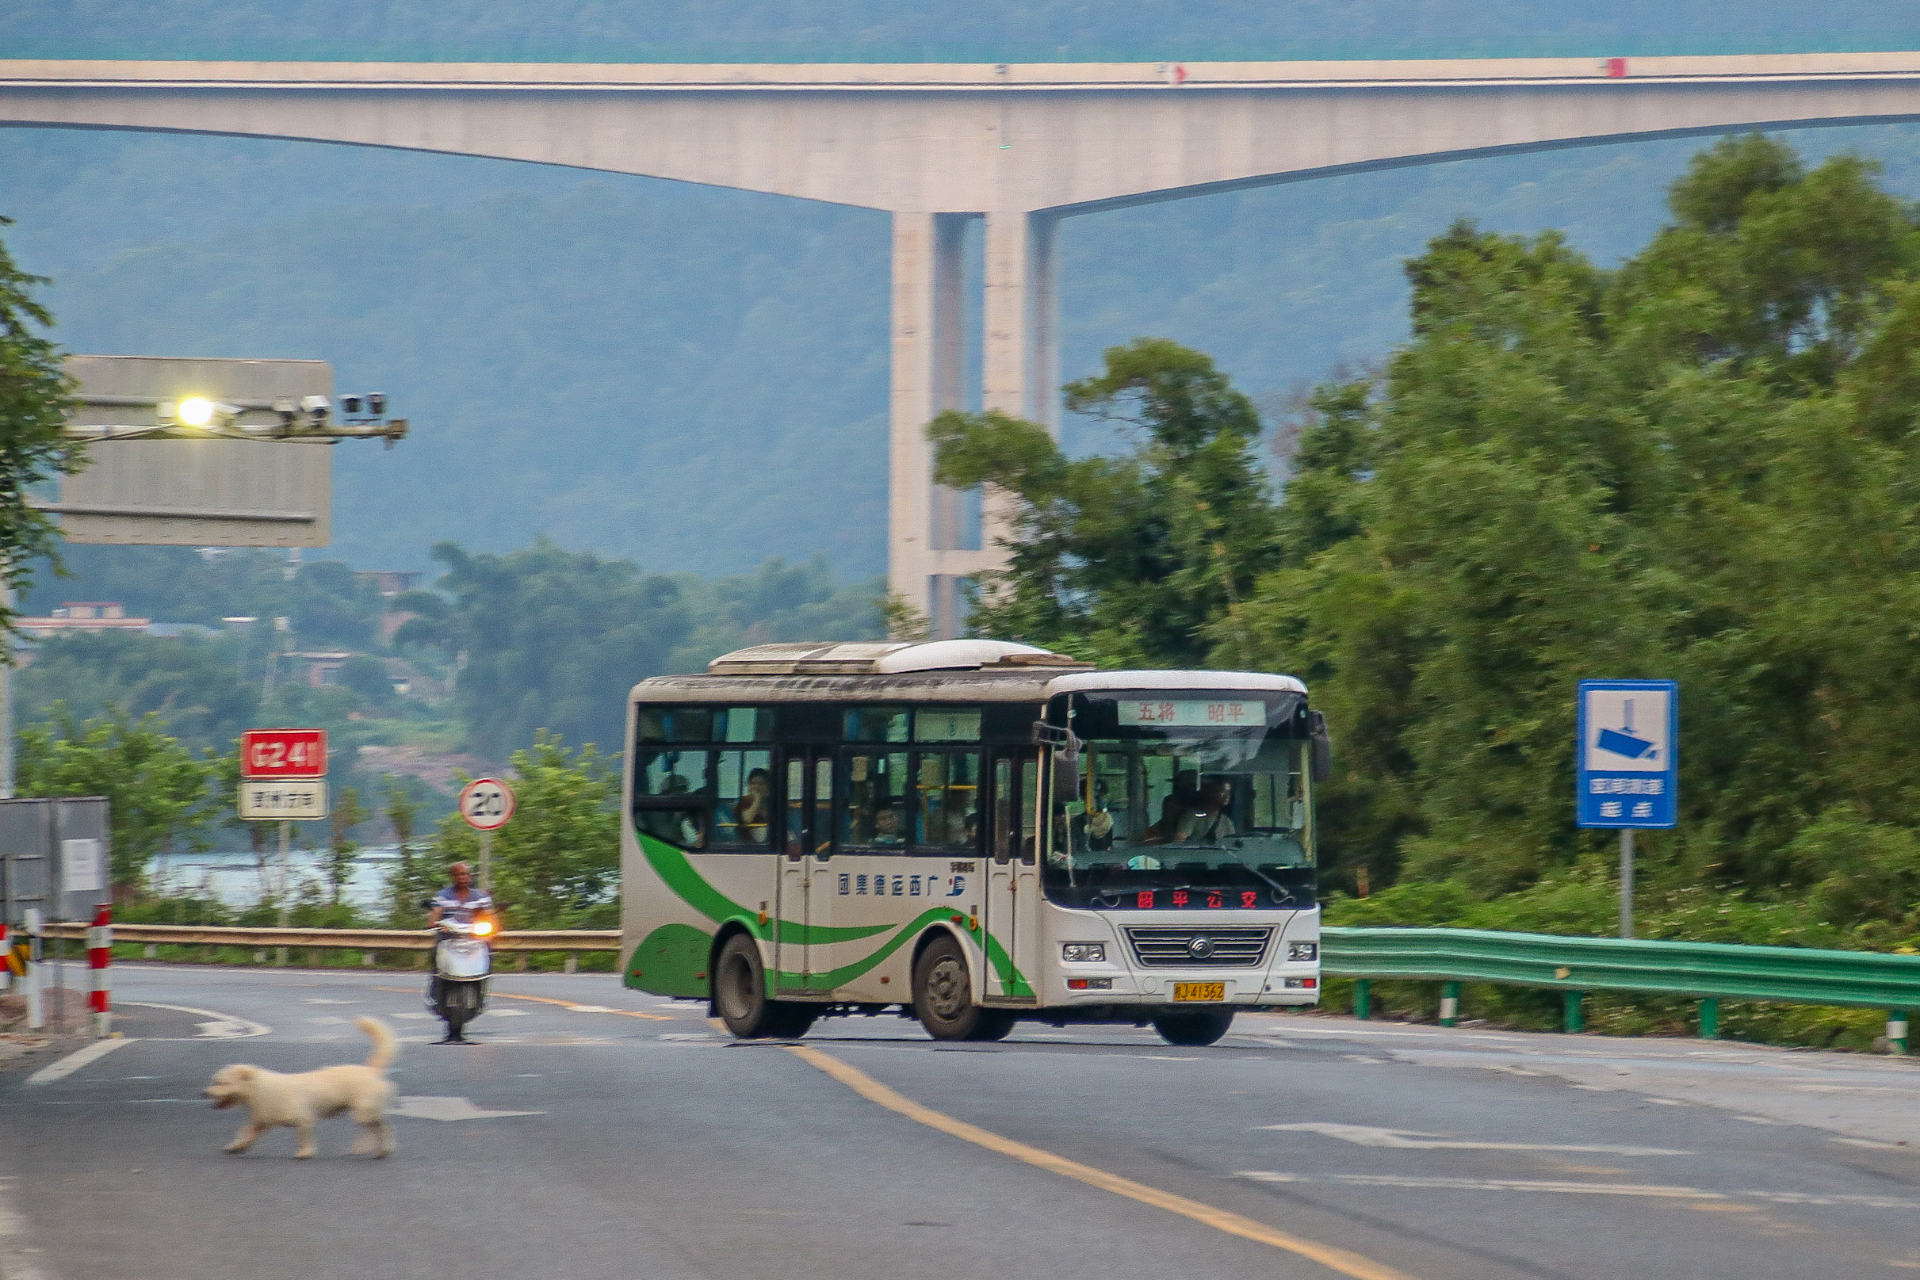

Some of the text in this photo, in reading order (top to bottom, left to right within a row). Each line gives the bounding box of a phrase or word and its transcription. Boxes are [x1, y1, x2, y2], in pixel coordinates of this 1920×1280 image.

[1207, 704, 1244, 722] 昭平
[251, 741, 319, 768] G241
[471, 792, 503, 816] 20
[1137, 890, 1257, 908] 昭平公交
